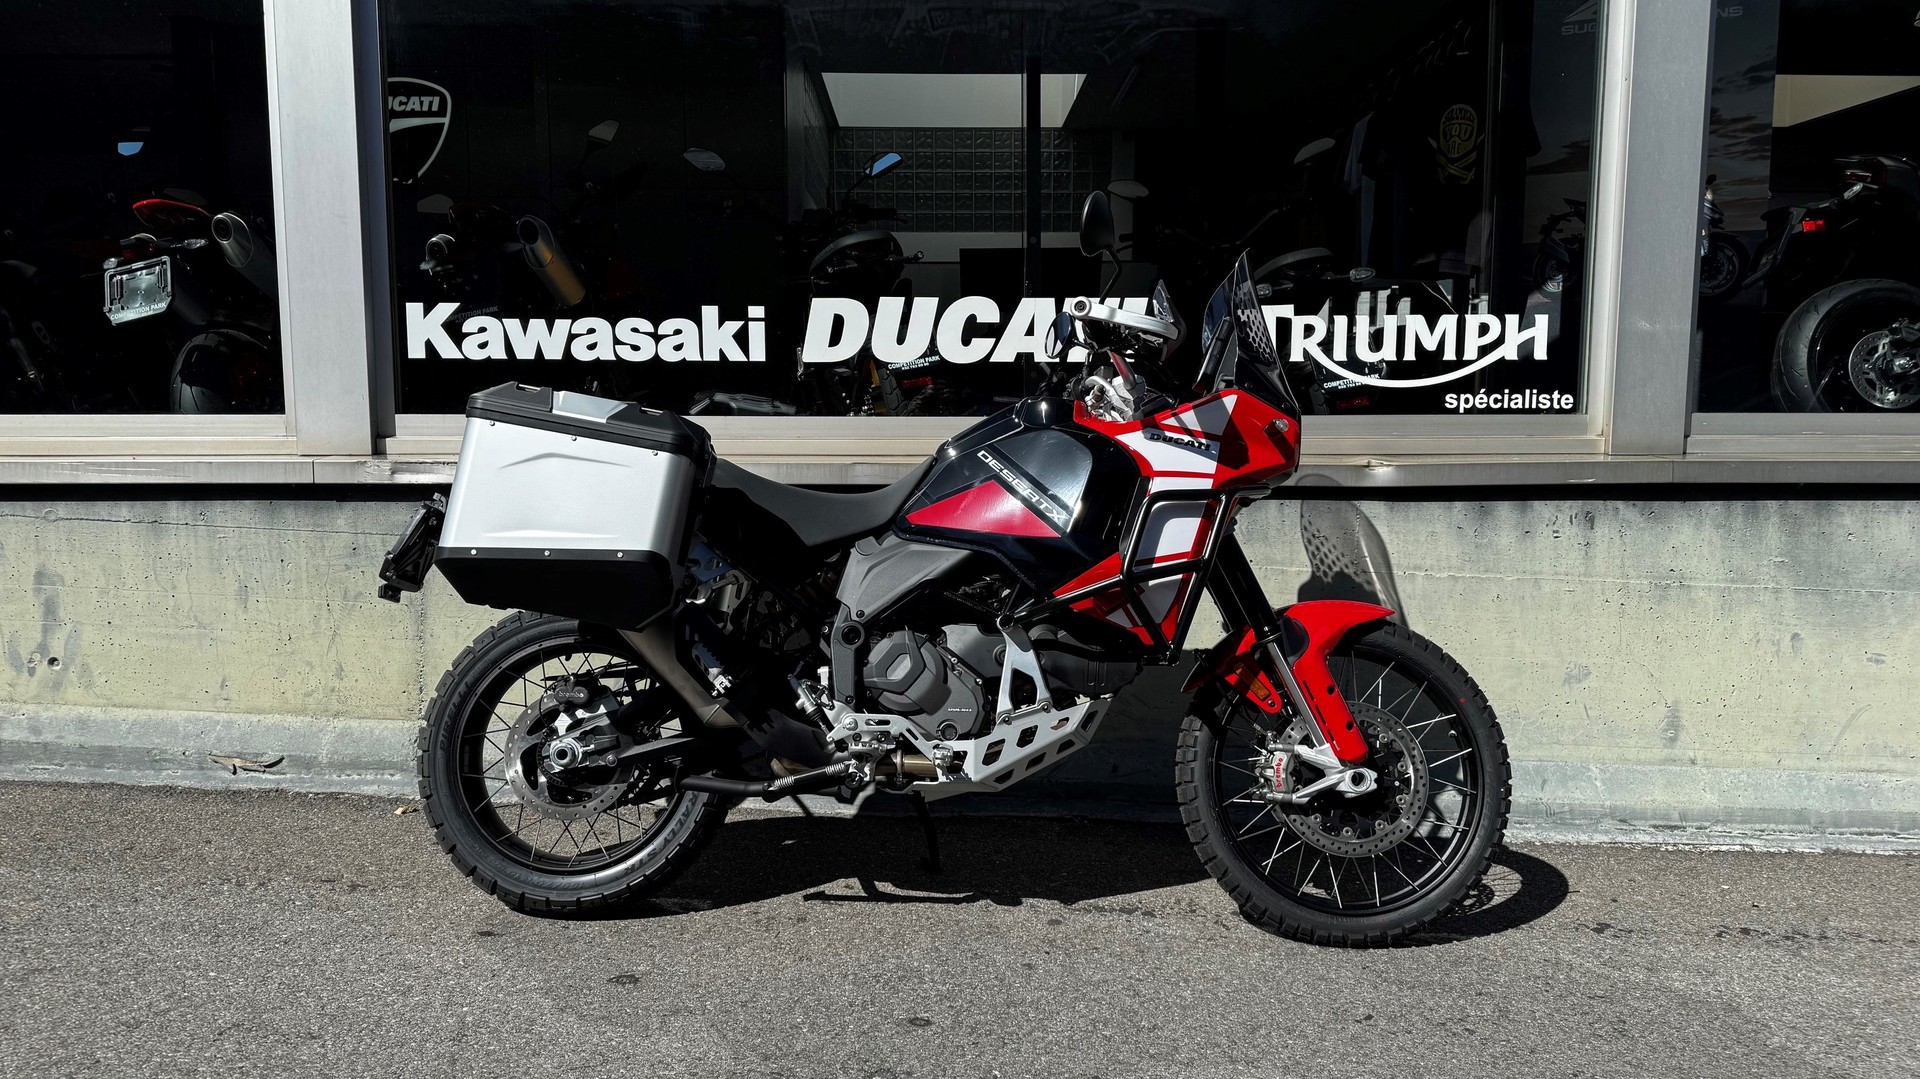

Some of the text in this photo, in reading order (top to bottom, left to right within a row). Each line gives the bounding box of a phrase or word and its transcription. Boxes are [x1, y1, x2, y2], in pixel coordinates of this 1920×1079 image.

[388, 96, 440, 111] CATI
[151, 301, 167, 310] PARK
[406, 303, 766, 362] Kawasaki
[1261, 304, 1549, 388] TRIUMPH
[925, 355, 941, 363] PARK
[1444, 389, 1574, 414] spécialiste
[1149, 432, 1211, 451] DUCATI
[977, 450, 1068, 523] DESERTX
[438, 680, 471, 751] PIRELLI
[1275, 757, 1284, 788] brembo
[658, 791, 700, 852] RALLY
